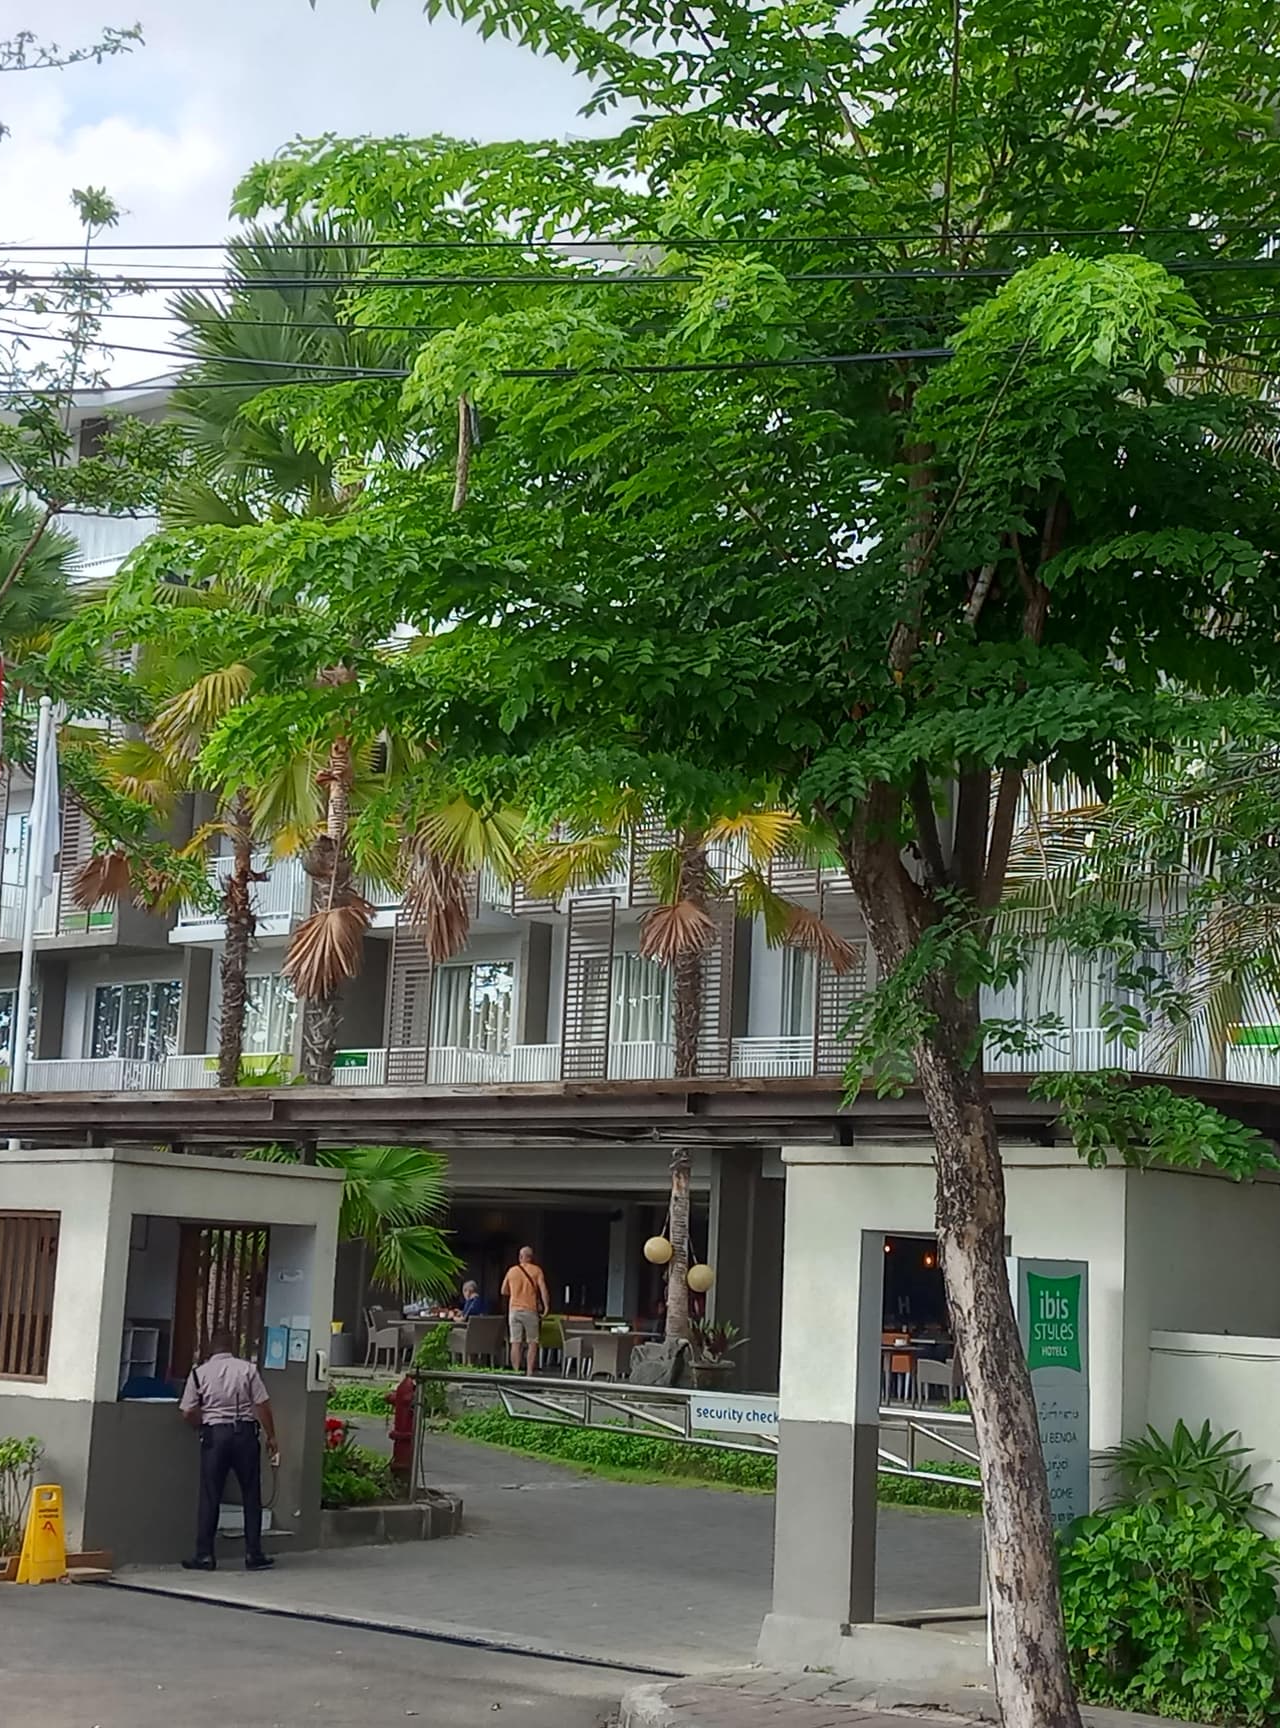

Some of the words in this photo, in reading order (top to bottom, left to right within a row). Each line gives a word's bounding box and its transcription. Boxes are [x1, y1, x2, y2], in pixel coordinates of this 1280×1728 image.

[1040, 1290, 1069, 1320] ibis
[1041, 1346, 1068, 1357] HOTELS
[696, 1407, 743, 1424] security
[746, 1410, 780, 1424] check
